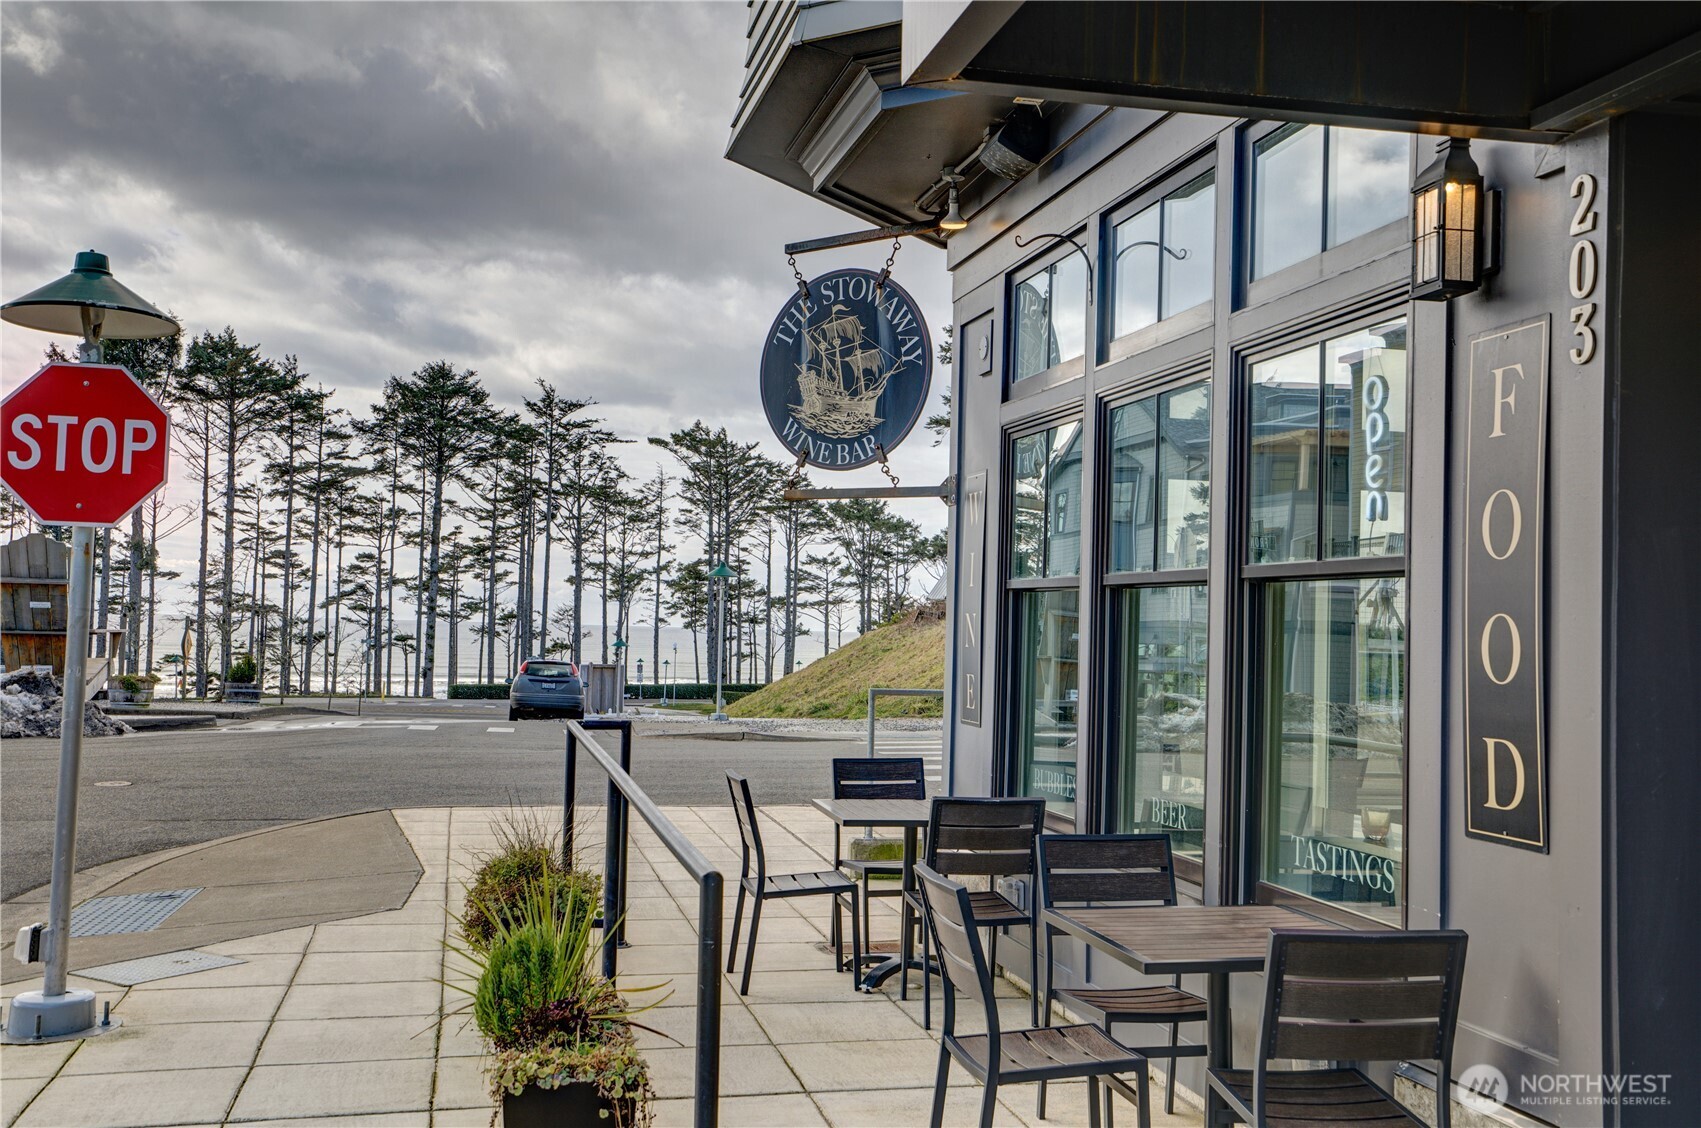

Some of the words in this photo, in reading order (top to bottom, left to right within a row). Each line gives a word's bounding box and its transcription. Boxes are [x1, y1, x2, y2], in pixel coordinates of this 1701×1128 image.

[1569, 173, 1598, 365] 203
[773, 297, 818, 347] THE
[820, 276, 923, 366] STOWAWAY
[7, 413, 157, 475] STOP
[782, 416, 833, 464] WINE
[836, 434, 876, 465] BAR
[1363, 375, 1384, 521] open
[965, 490, 982, 710] WINE
[1481, 363, 1525, 811] FOOD
[1152, 797, 1188, 831] BEER
[1291, 835, 1395, 894] TASTINGS
